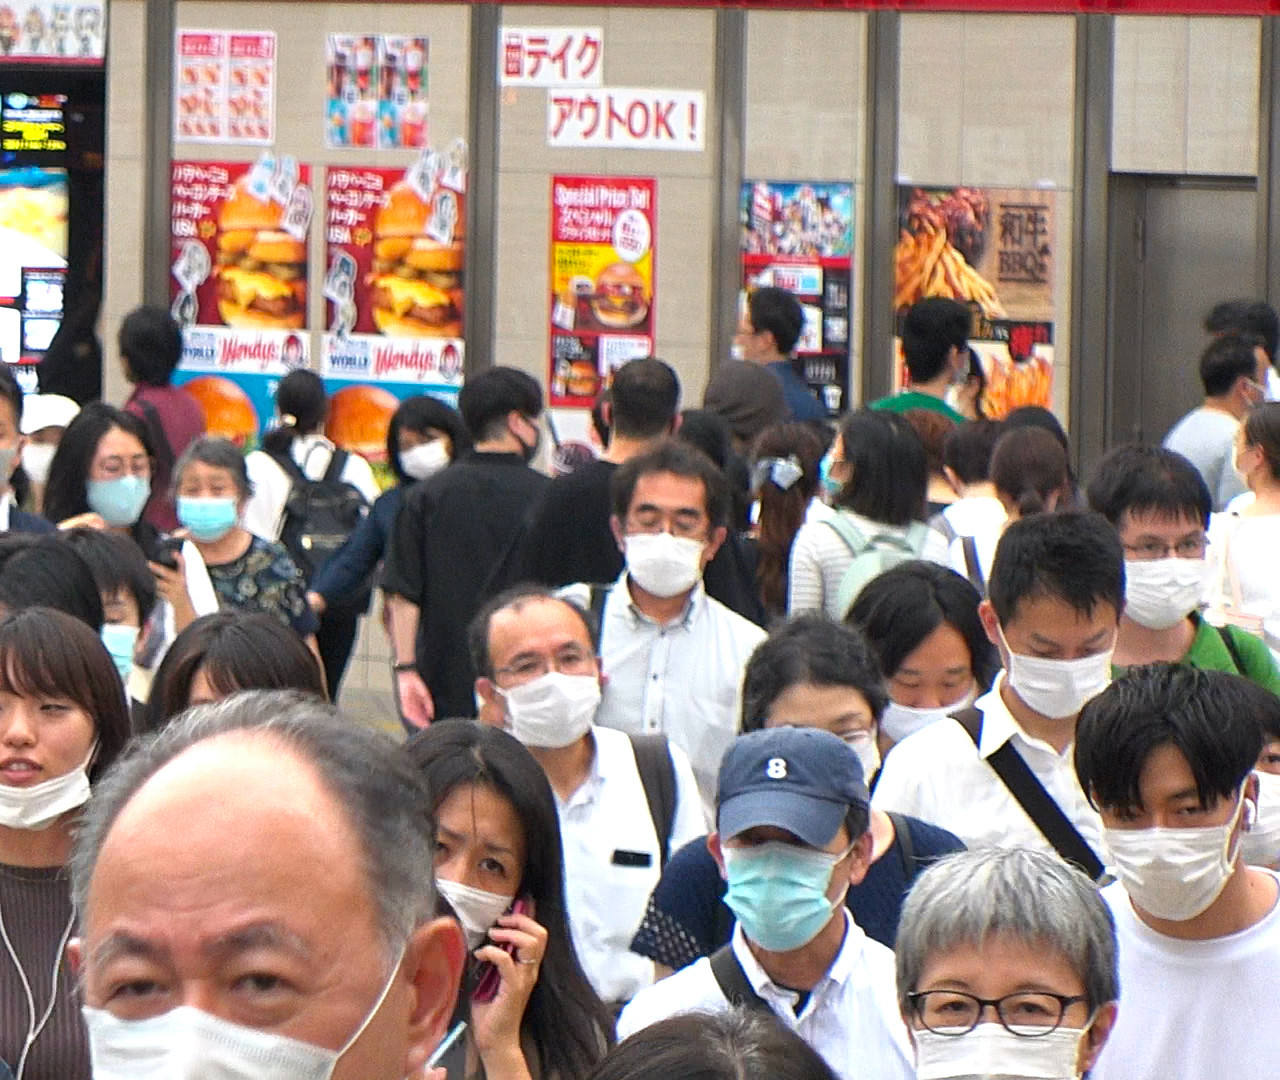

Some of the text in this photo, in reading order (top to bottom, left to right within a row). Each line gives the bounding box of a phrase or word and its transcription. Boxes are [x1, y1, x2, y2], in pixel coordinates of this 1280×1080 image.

[527, 35, 600, 79] テイク
[1000, 212, 1047, 247] 和牛
[767, 758, 787, 779] 8
